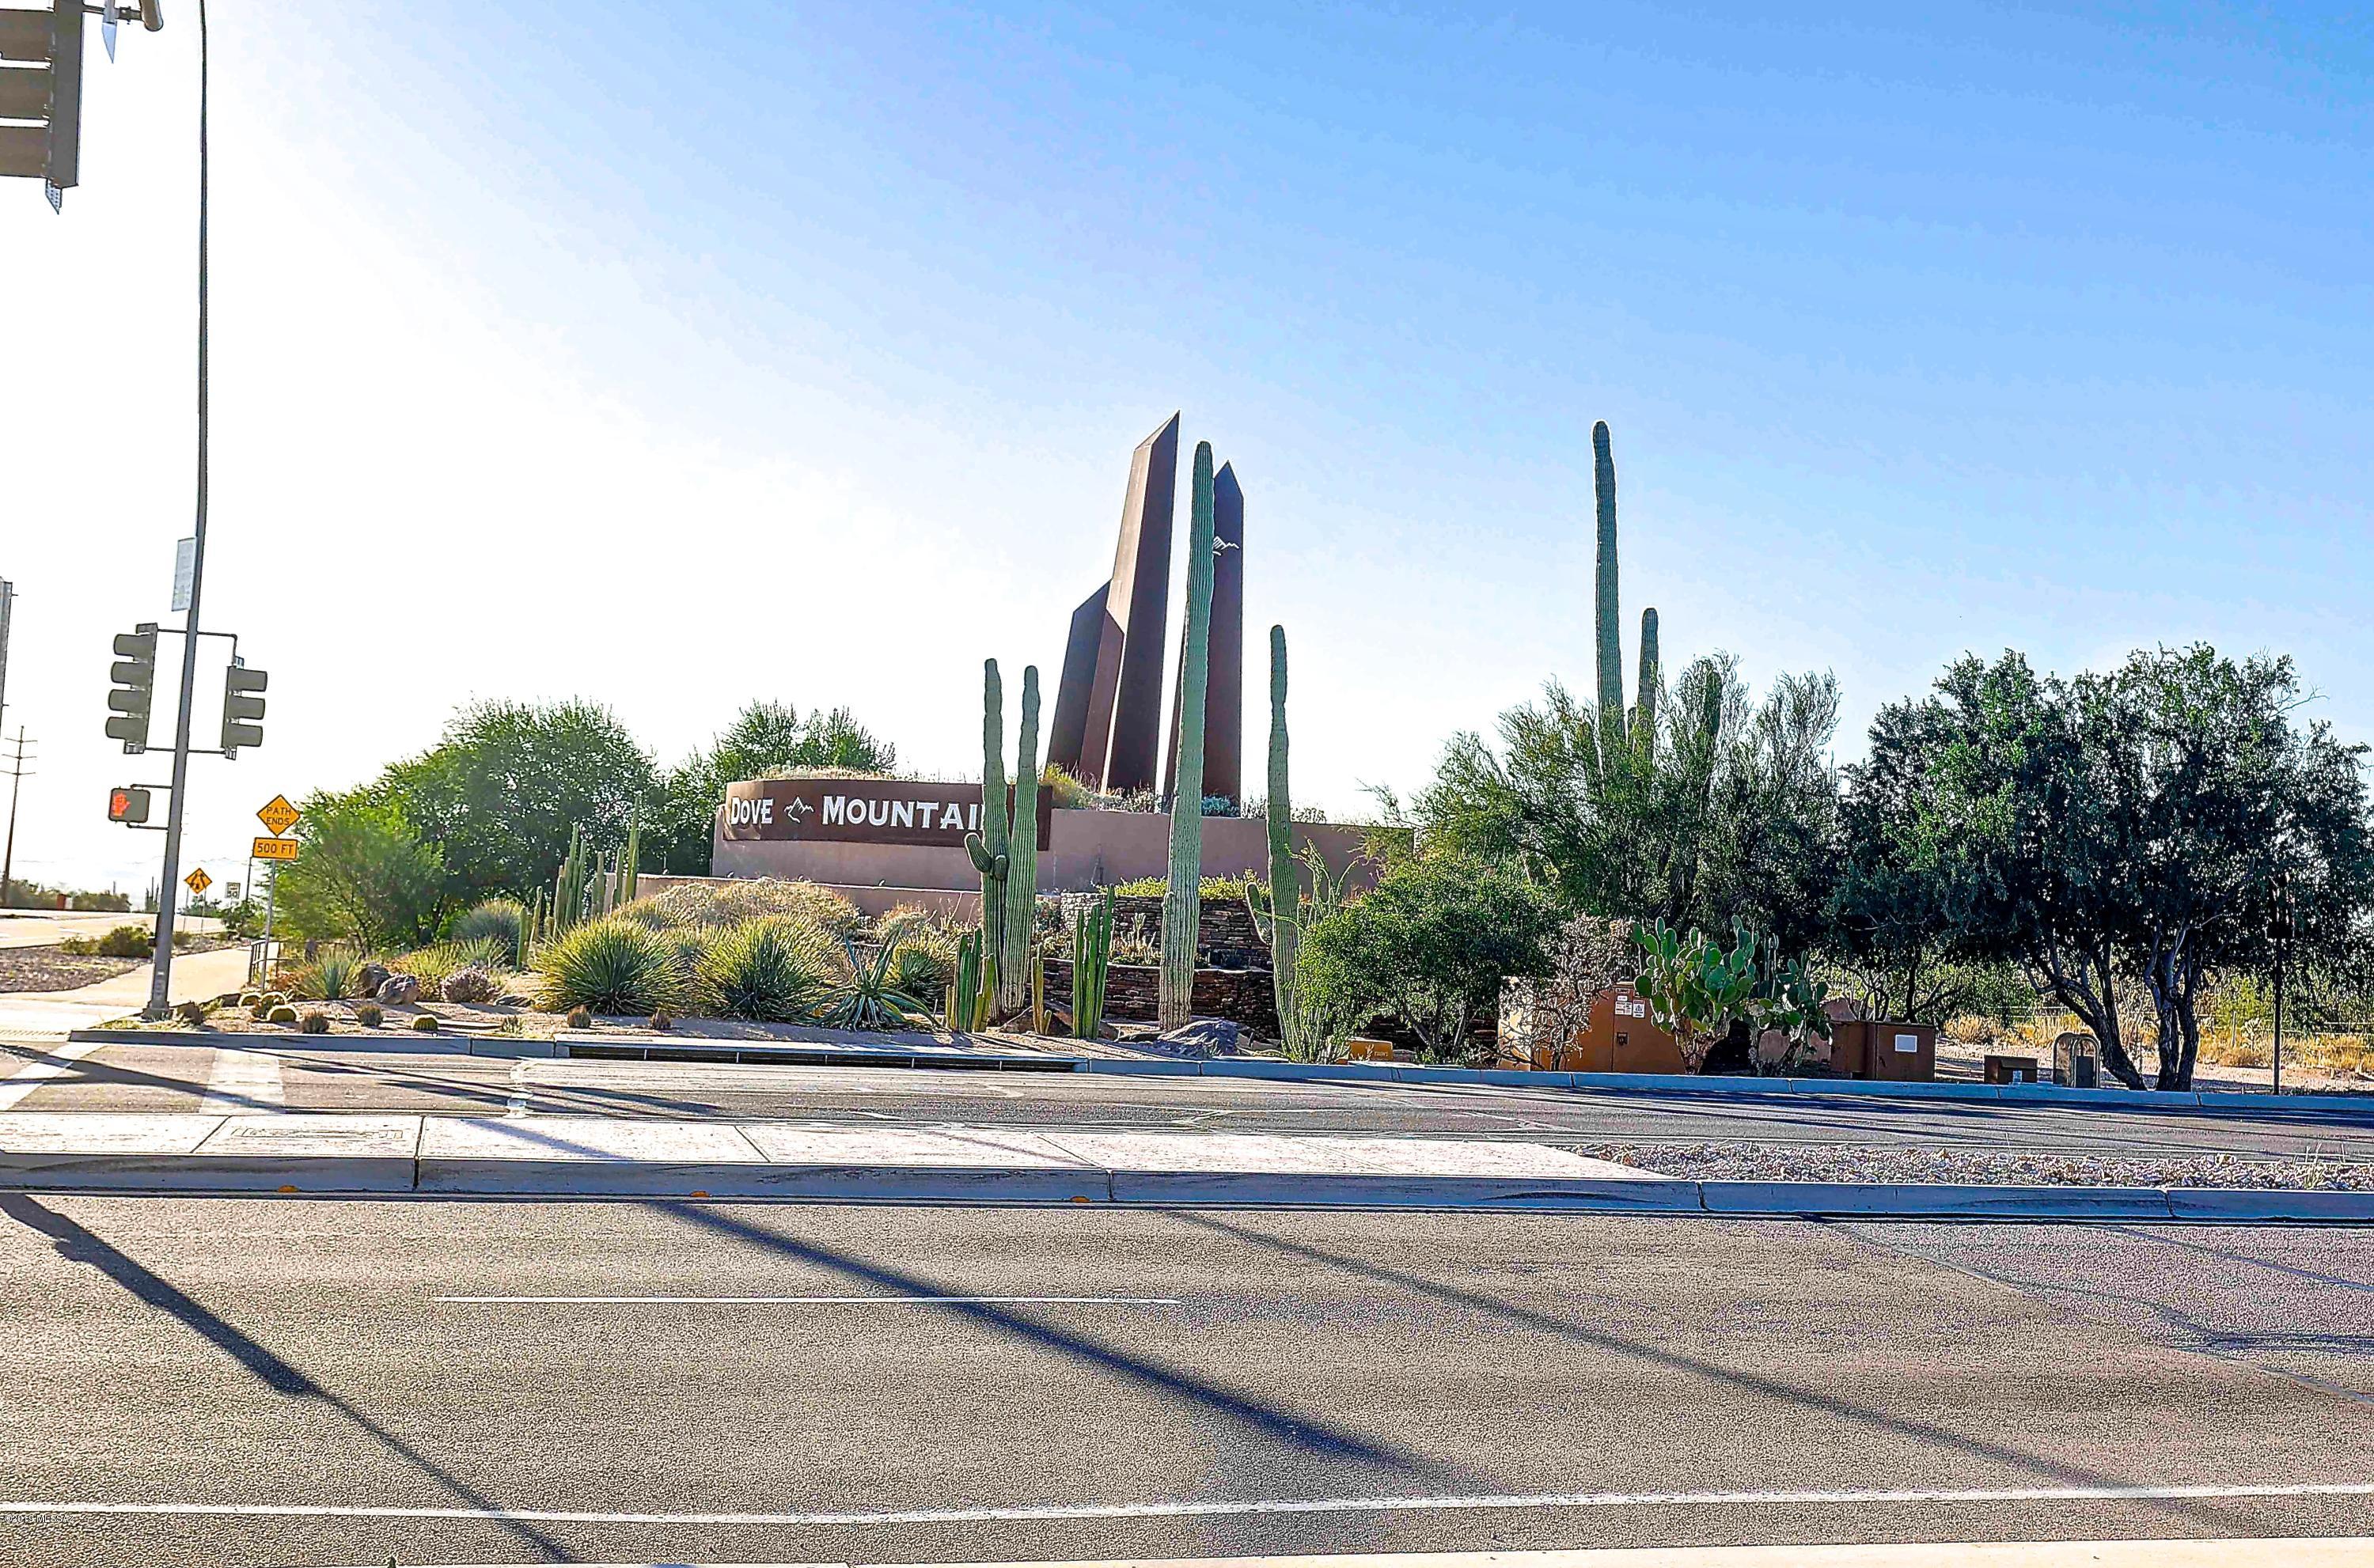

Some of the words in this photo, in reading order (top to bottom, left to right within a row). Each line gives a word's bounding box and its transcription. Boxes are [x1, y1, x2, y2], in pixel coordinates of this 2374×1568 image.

[266, 807, 291, 816] PATH
[731, 797, 774, 824] DOVE
[822, 795, 984, 830] MOUNTAI
[266, 816, 290, 825] ENDS
[257, 843, 277, 854] 500
[281, 843, 294, 854] FT
